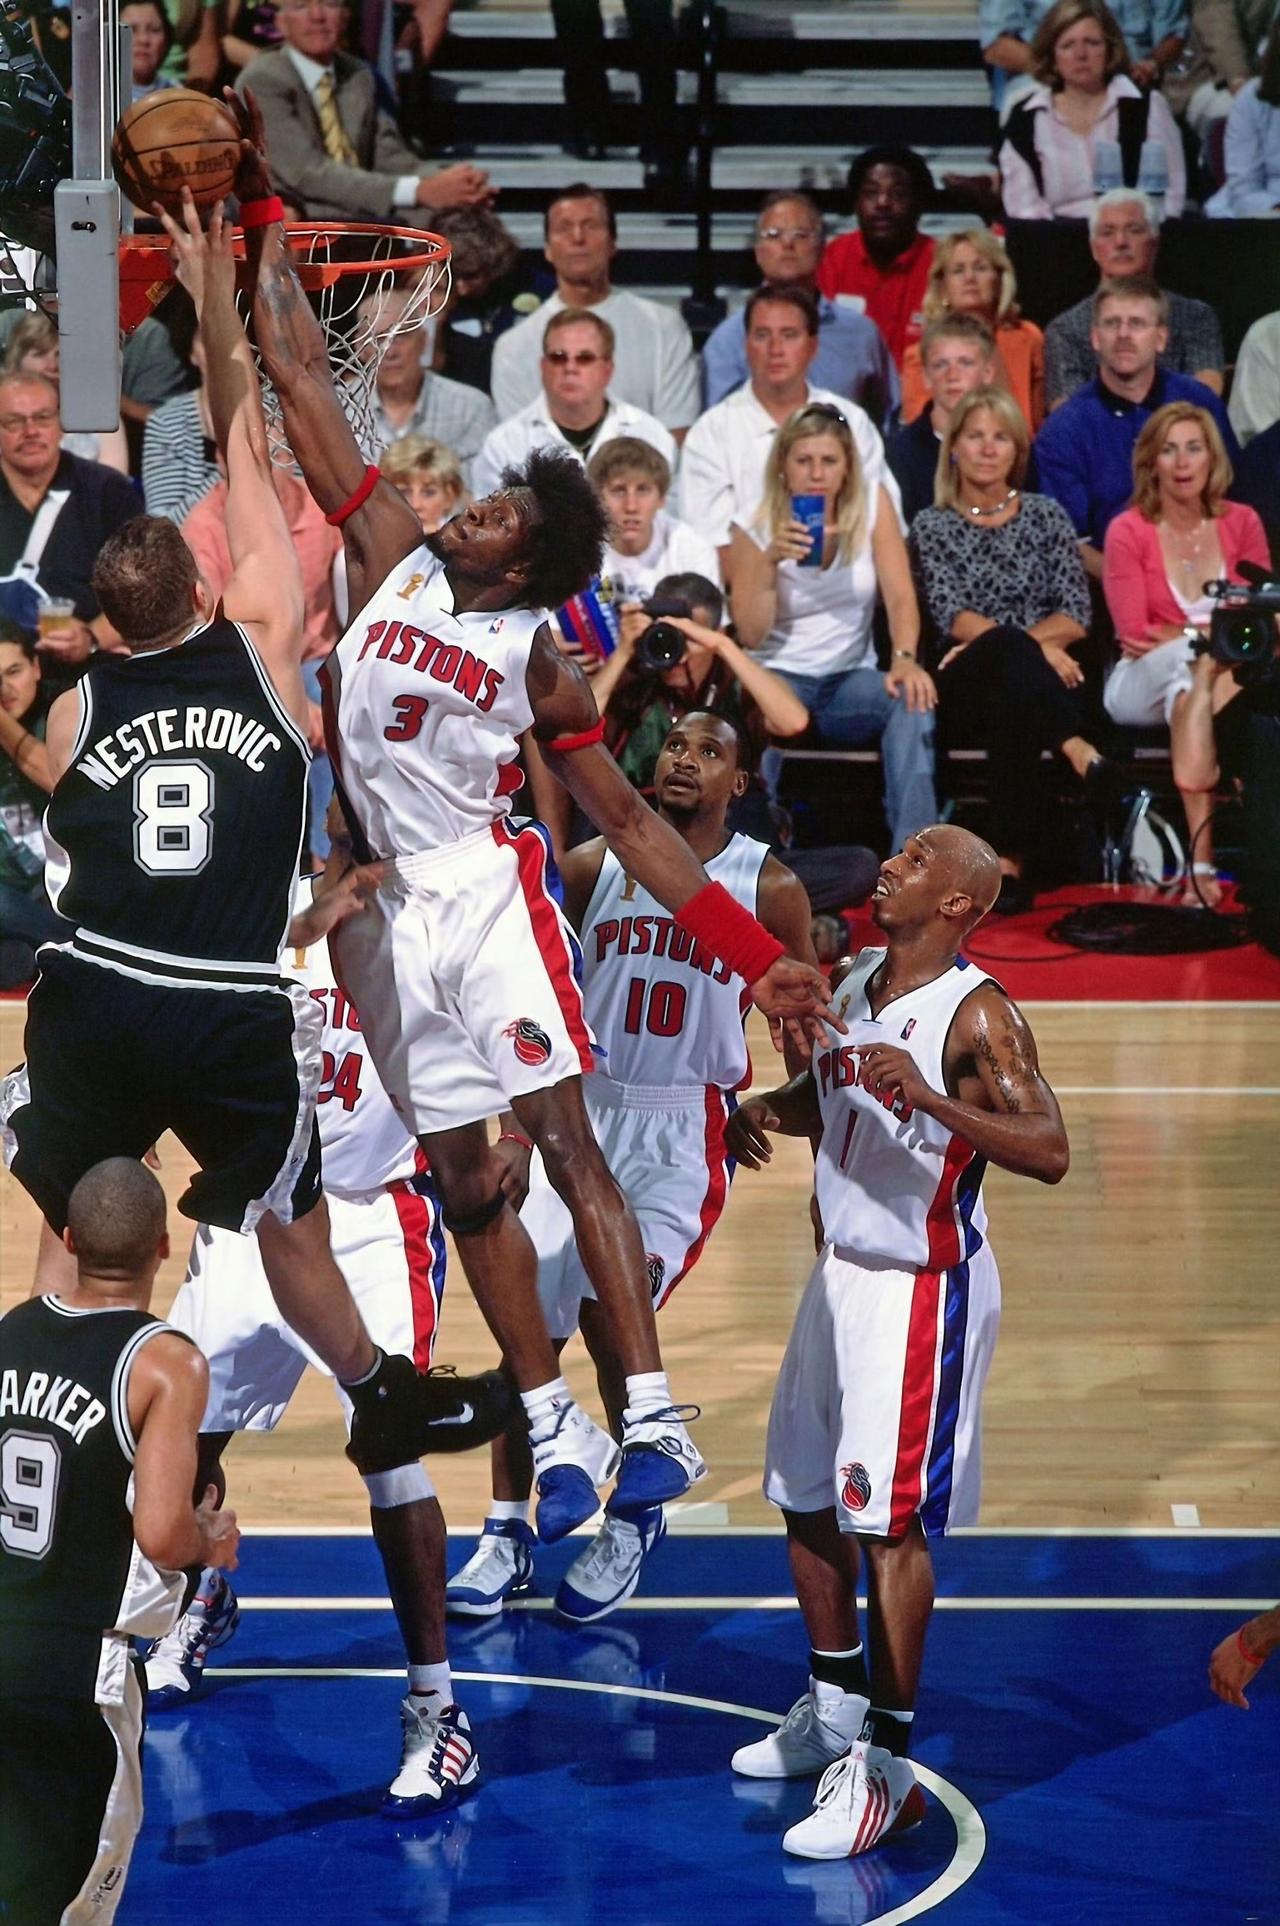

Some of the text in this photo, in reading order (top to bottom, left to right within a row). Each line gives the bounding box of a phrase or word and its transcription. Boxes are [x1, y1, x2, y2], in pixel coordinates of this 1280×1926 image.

[357, 620, 505, 713] PISTONS
[76, 706, 281, 792] NESTEROVIC
[384, 694, 429, 742] 3
[132, 757, 216, 877] 8
[625, 977, 687, 1037] 10
[839, 1109, 858, 1169] 1
[0, 1369, 106, 1445] ARKER
[0, 1428, 62, 1561] 9
